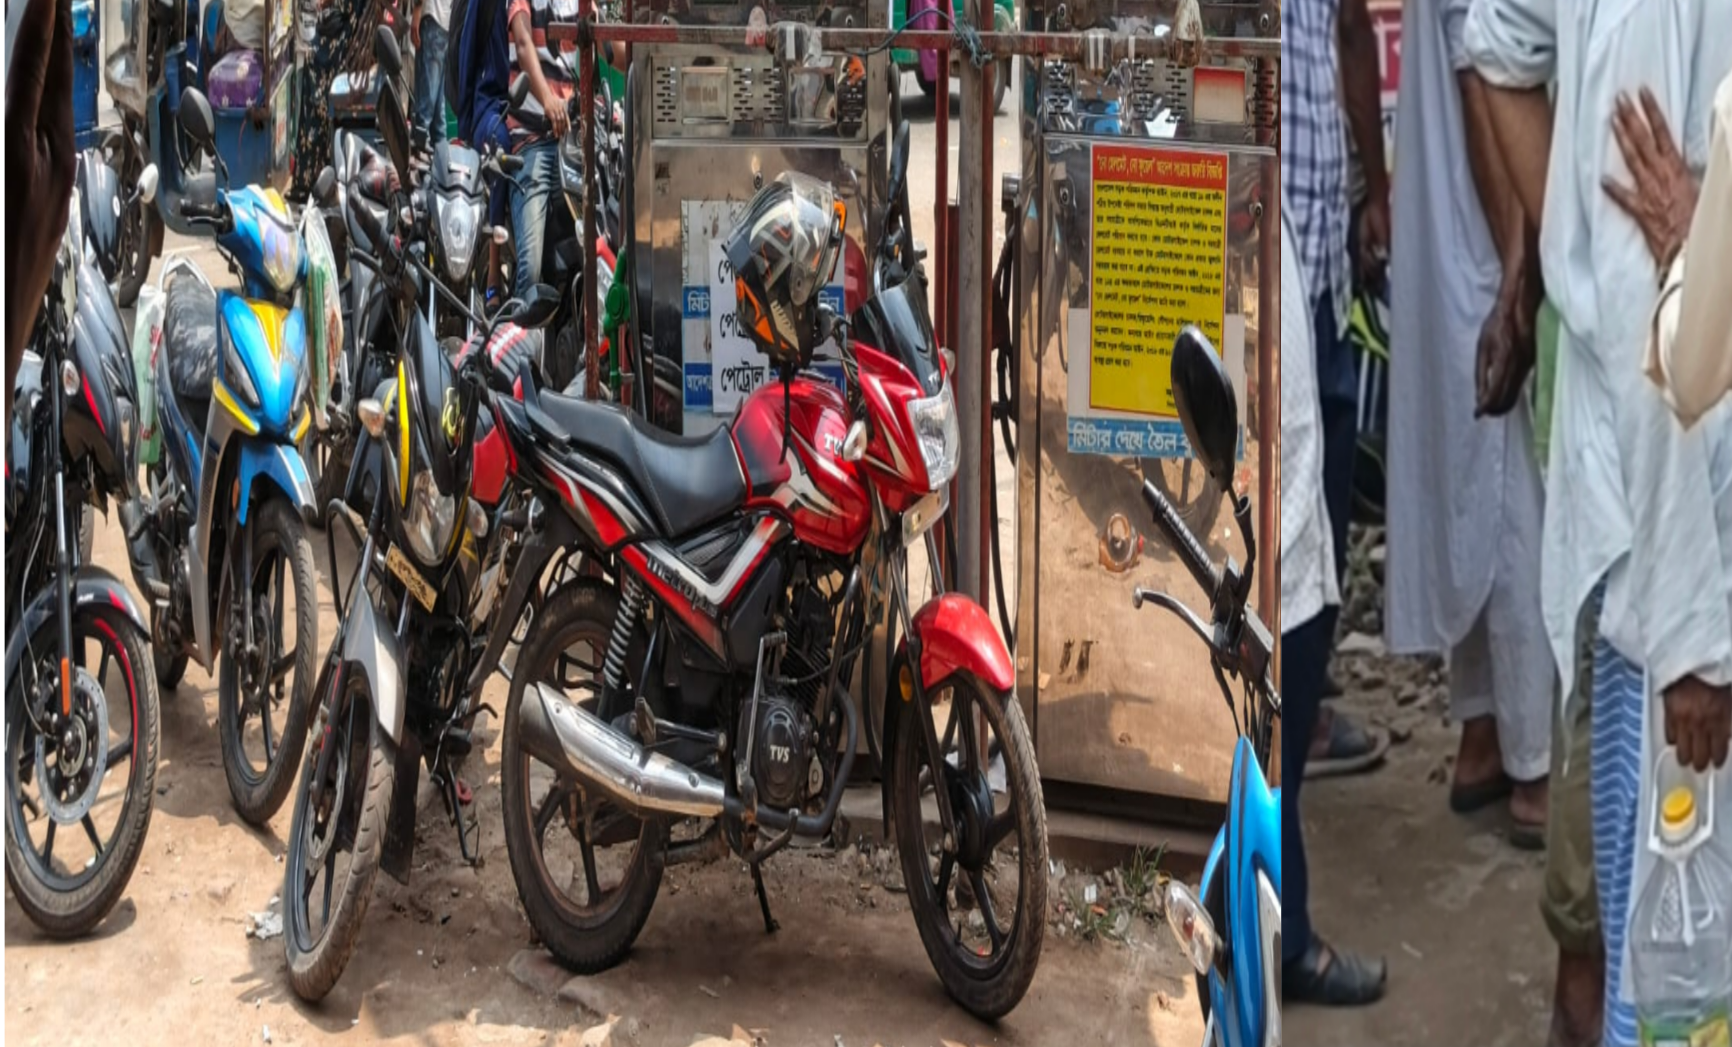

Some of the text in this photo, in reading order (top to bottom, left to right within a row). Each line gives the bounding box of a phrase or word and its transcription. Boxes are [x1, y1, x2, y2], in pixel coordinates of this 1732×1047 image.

[720, 359, 765, 393] পেট্রোল
[824, 432, 843, 456] TV
[1072, 420, 1111, 449] মিটার
[1115, 424, 1144, 450] দেখে
[769, 744, 790, 763] TVS
